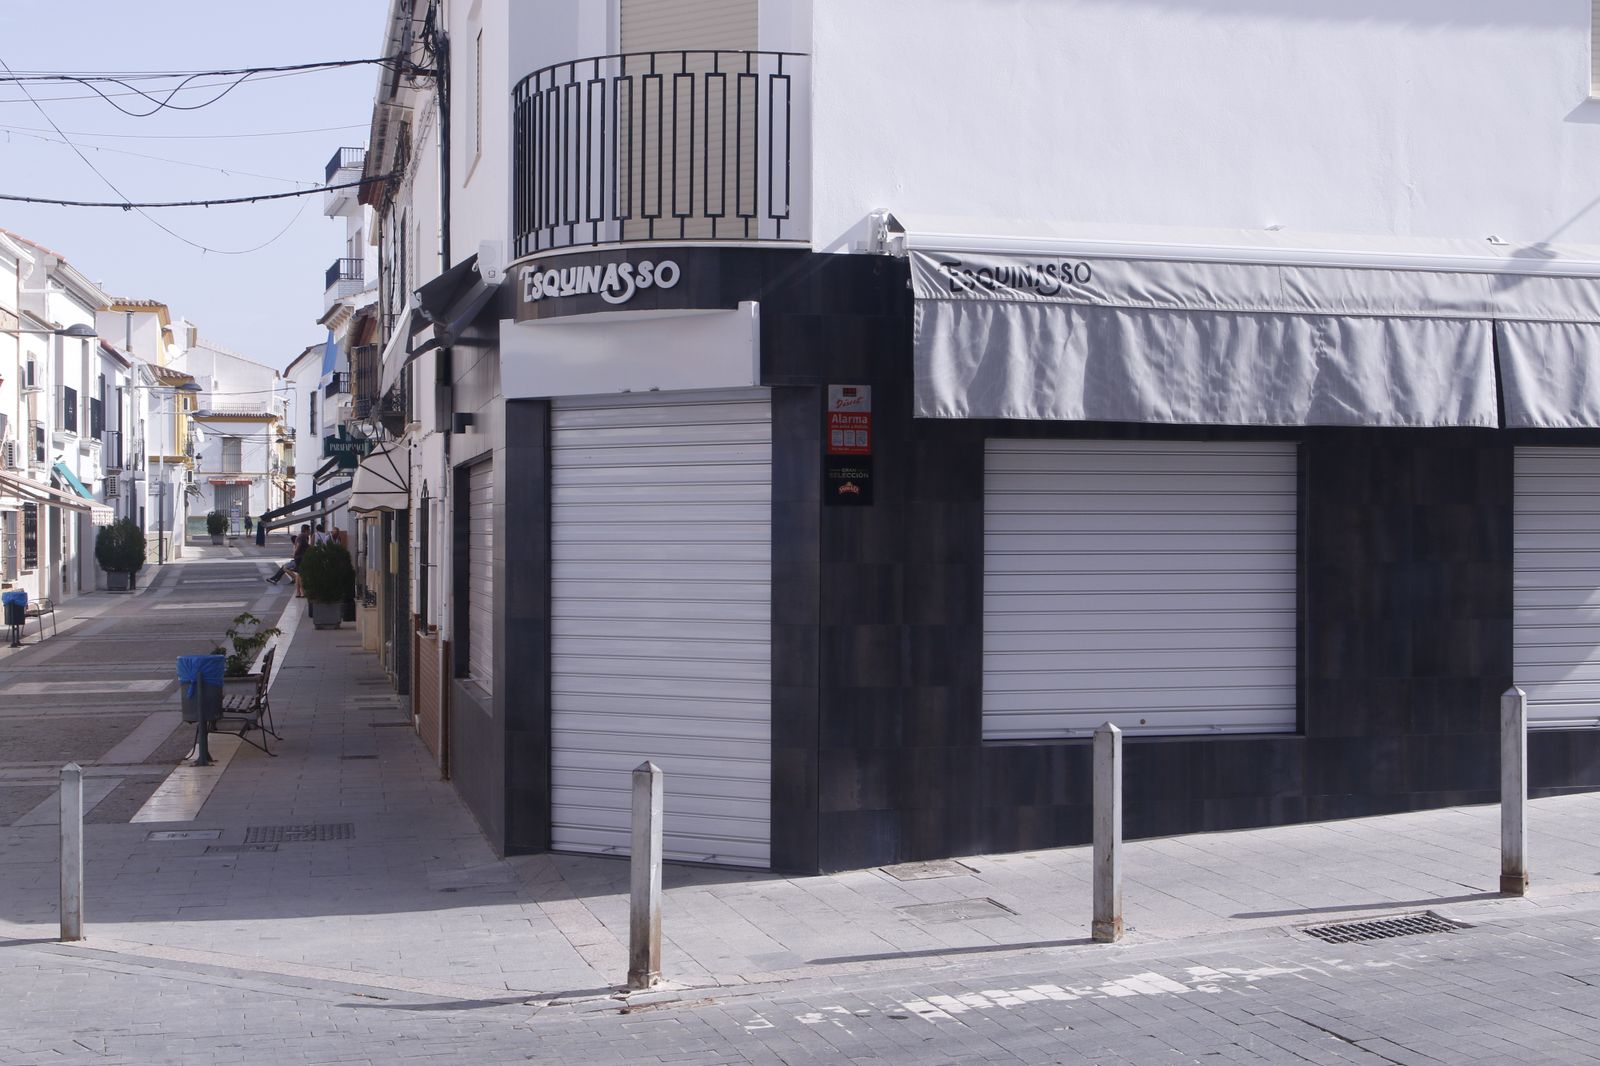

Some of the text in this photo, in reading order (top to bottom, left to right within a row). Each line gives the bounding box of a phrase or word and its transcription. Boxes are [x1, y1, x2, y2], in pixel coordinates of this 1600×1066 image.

[519, 260, 681, 304] ESQUINASSO
[940, 261, 1092, 296] ESQUINASSO
[832, 414, 868, 424] Alarma
